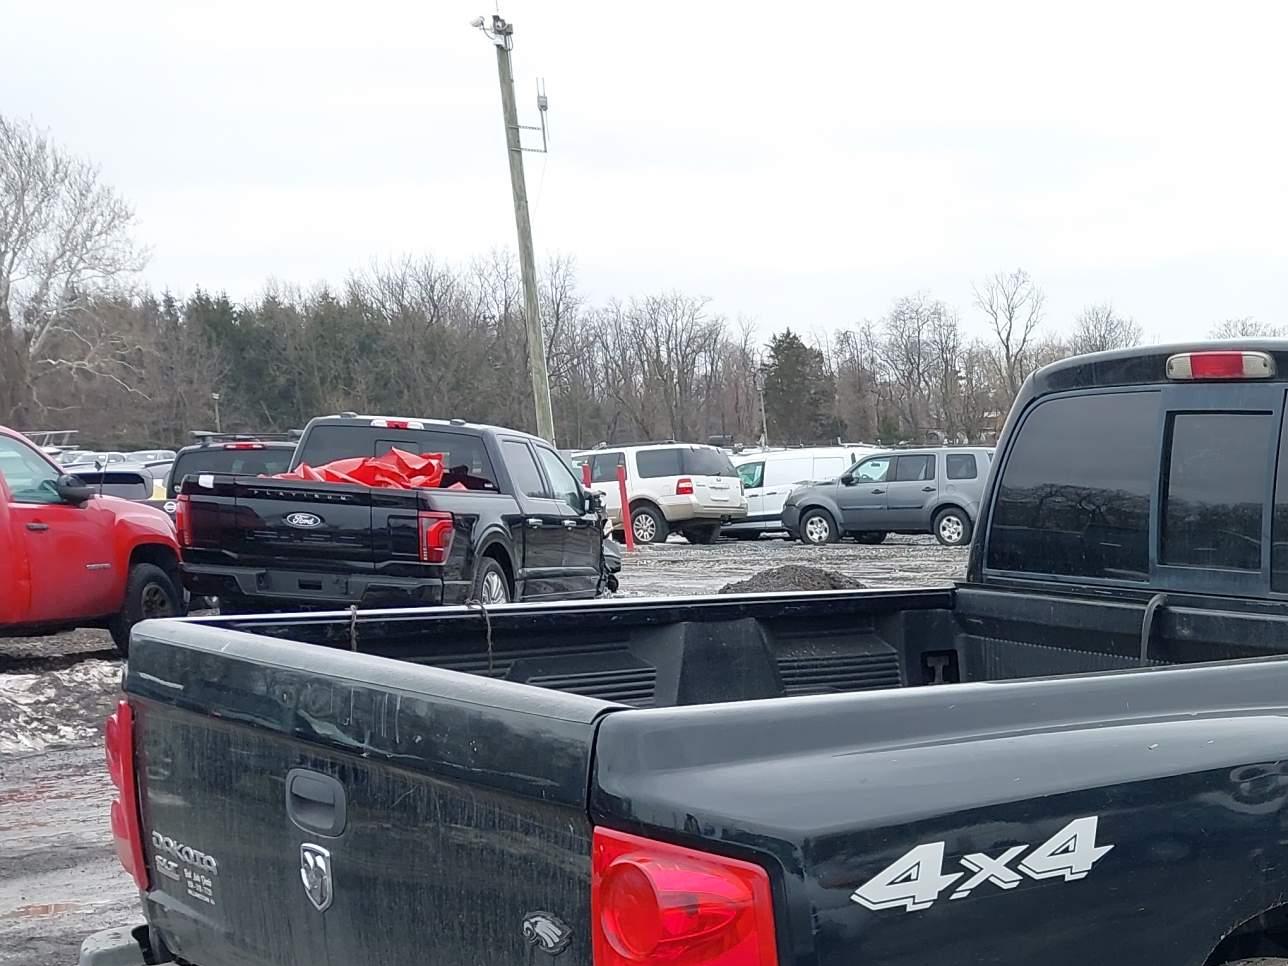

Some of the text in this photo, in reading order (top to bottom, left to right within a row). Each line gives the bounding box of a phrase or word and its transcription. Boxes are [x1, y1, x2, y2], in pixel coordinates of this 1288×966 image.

[253, 489, 347, 500] PLATINUM
[292, 513, 315, 525] Ford
[152, 830, 218, 875] DAKOTA
[850, 815, 1115, 912] 4x4
